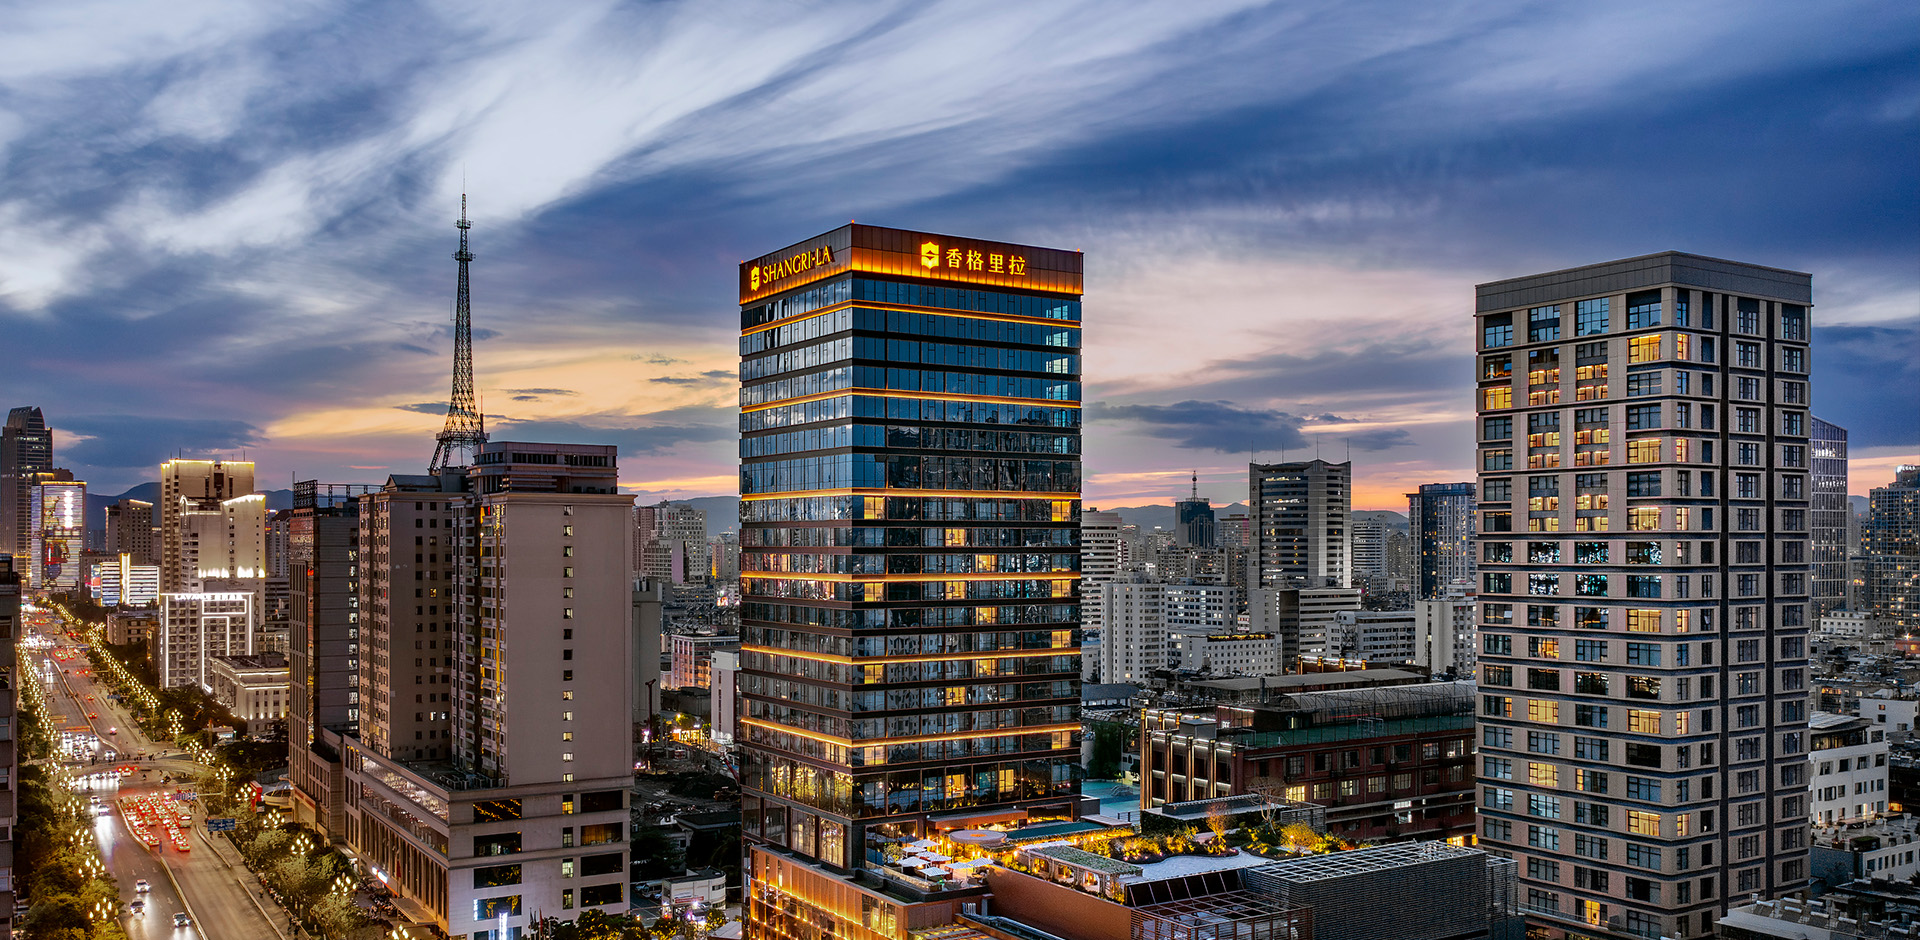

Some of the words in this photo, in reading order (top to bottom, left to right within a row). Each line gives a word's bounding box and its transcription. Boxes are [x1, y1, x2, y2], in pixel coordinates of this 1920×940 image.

[762, 244, 831, 284] SHANGRI-LA
[945, 247, 1026, 276] 香格里拉
